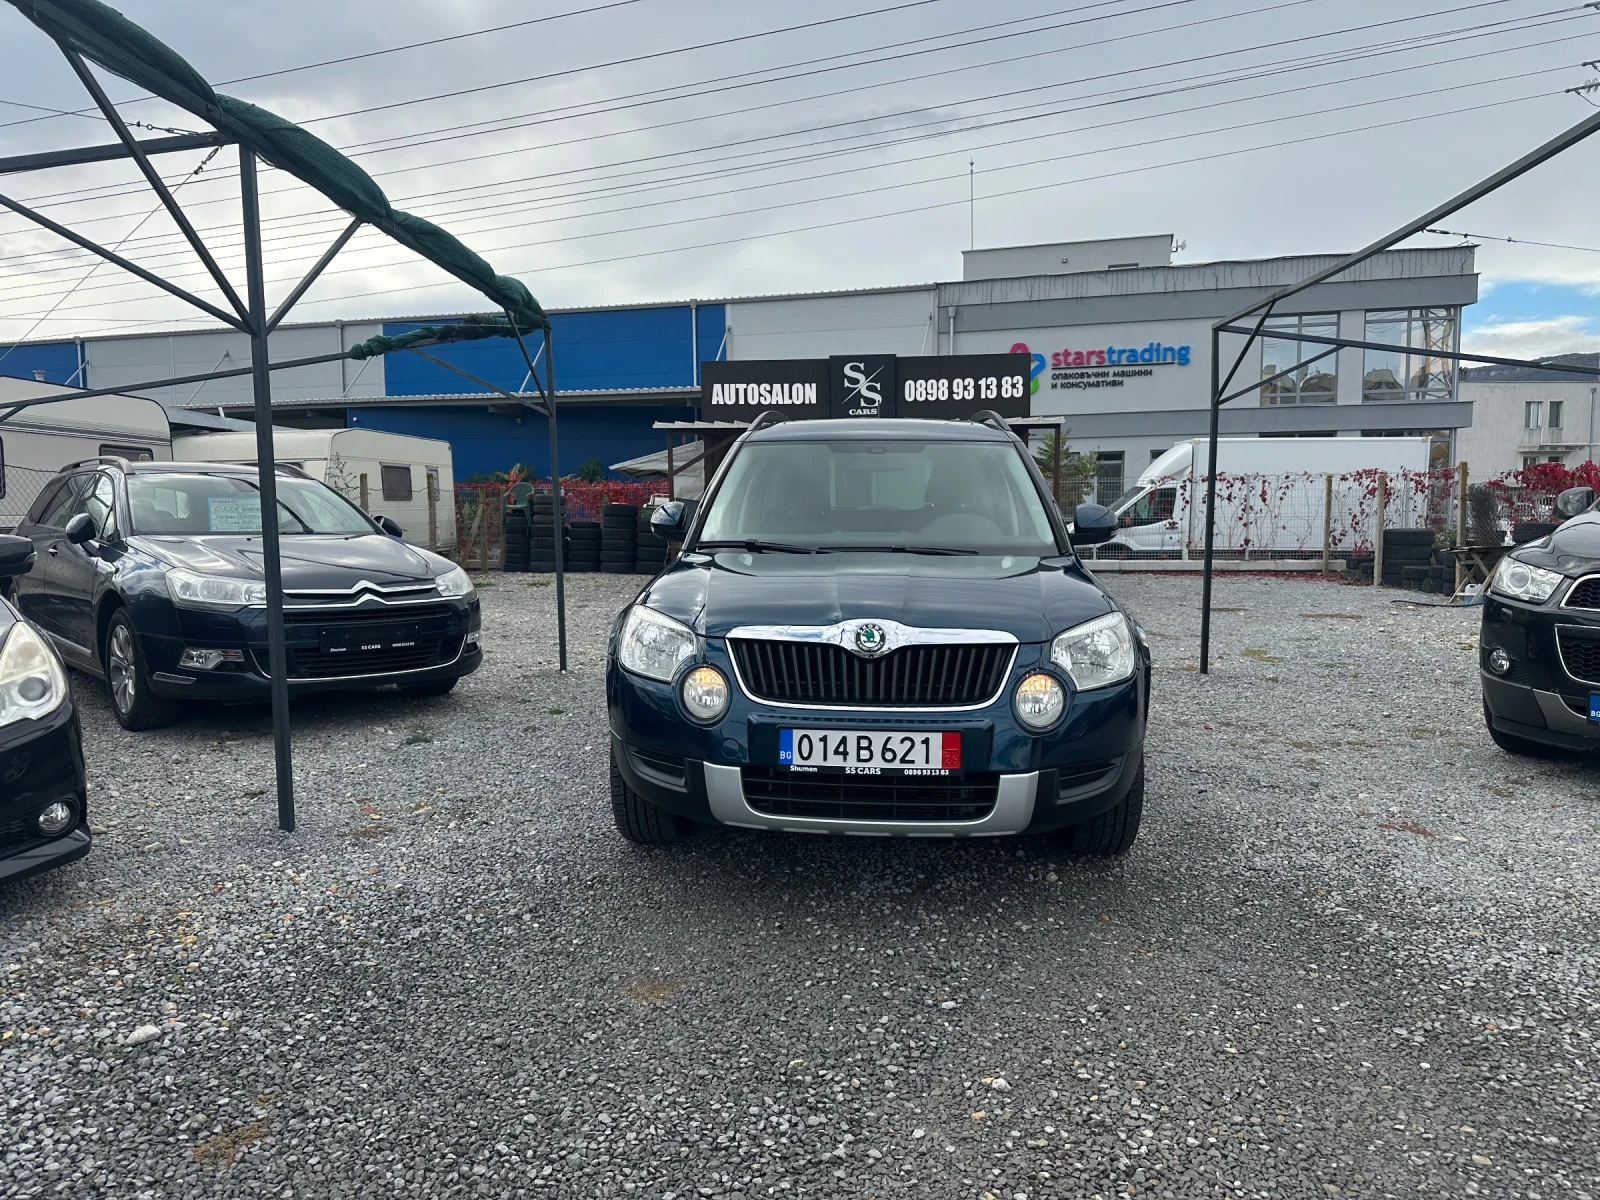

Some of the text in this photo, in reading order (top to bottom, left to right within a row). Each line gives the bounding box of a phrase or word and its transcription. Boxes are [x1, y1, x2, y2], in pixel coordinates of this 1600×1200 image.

[1051, 342, 1190, 366] starstrading
[1051, 367, 1152, 381] опаковъчни машини
[904, 375, 1023, 401] 0898 93 13 83
[1051, 379, 1124, 391] и консумативи
[711, 383, 816, 405] AUTOSALON
[848, 408, 878, 416] CARS
[780, 751, 792, 760] BG
[789, 764, 818, 773] Shumen
[845, 767, 882, 775] SS CARS
